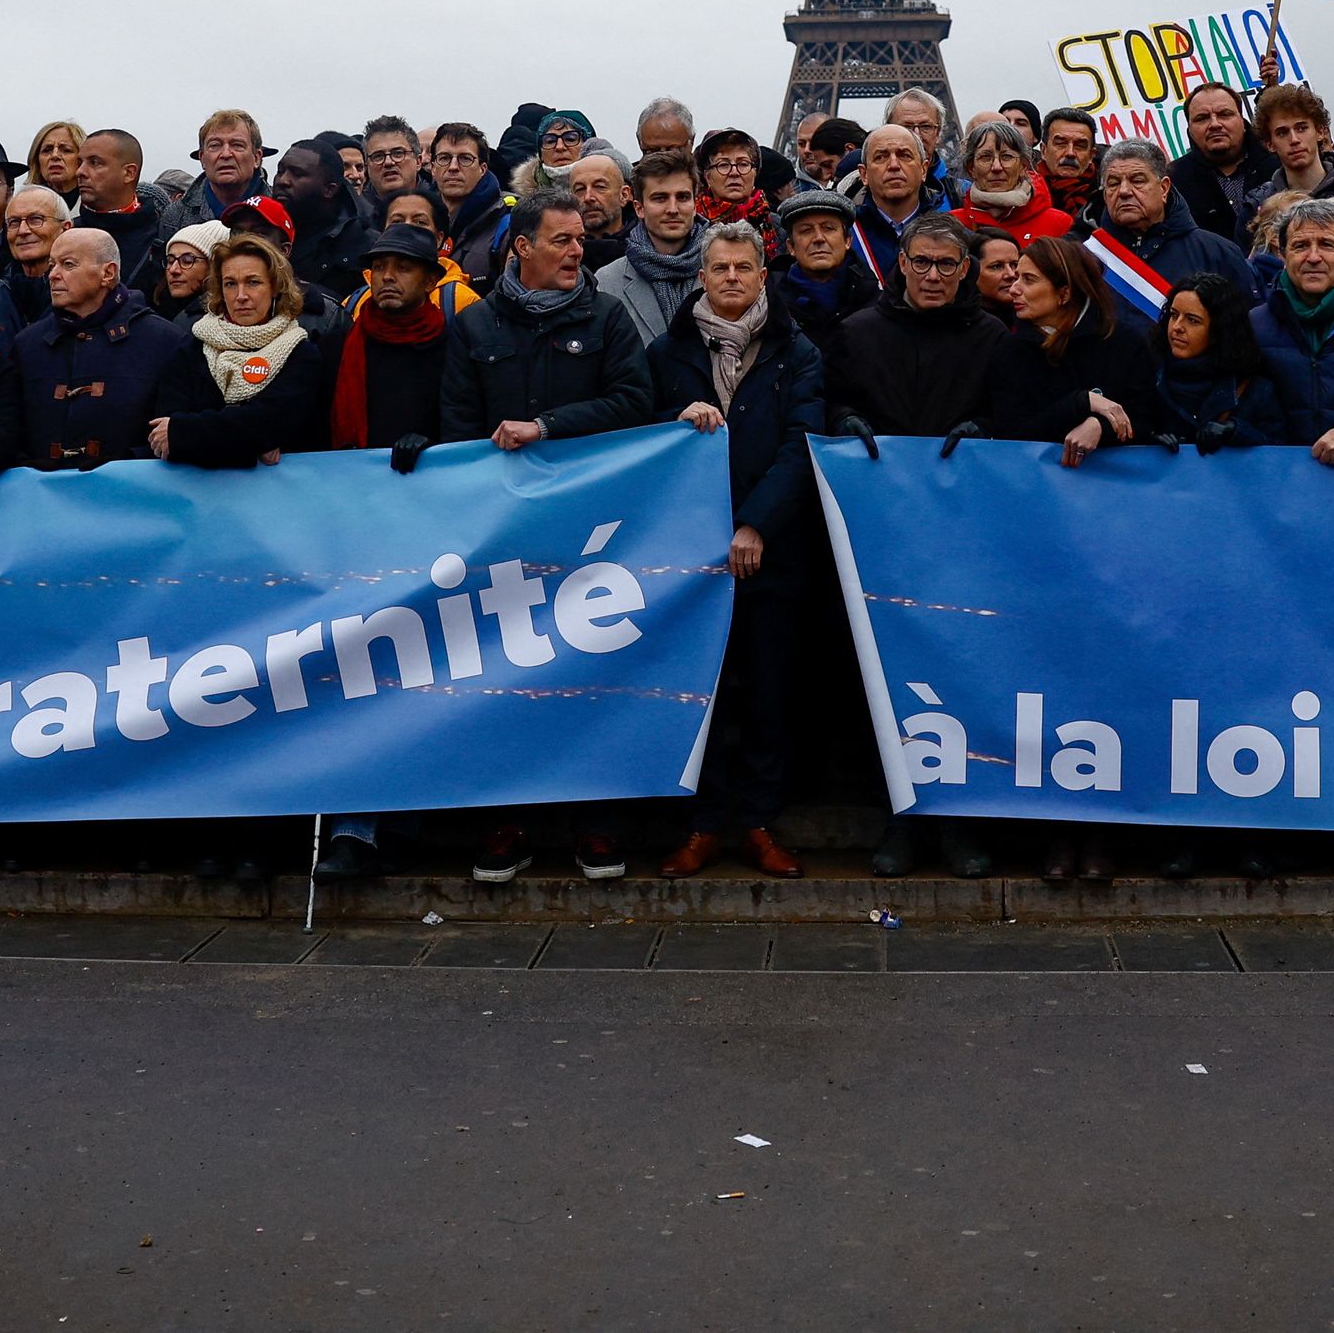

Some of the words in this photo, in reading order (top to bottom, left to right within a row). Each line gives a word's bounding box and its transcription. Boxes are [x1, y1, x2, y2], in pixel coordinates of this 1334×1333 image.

[1058, 22, 1194, 113] STOP
[247, 196, 261, 207] NY
[902, 682, 967, 785] à
[1016, 692, 1122, 791] la
[1171, 690, 1321, 798] loi
